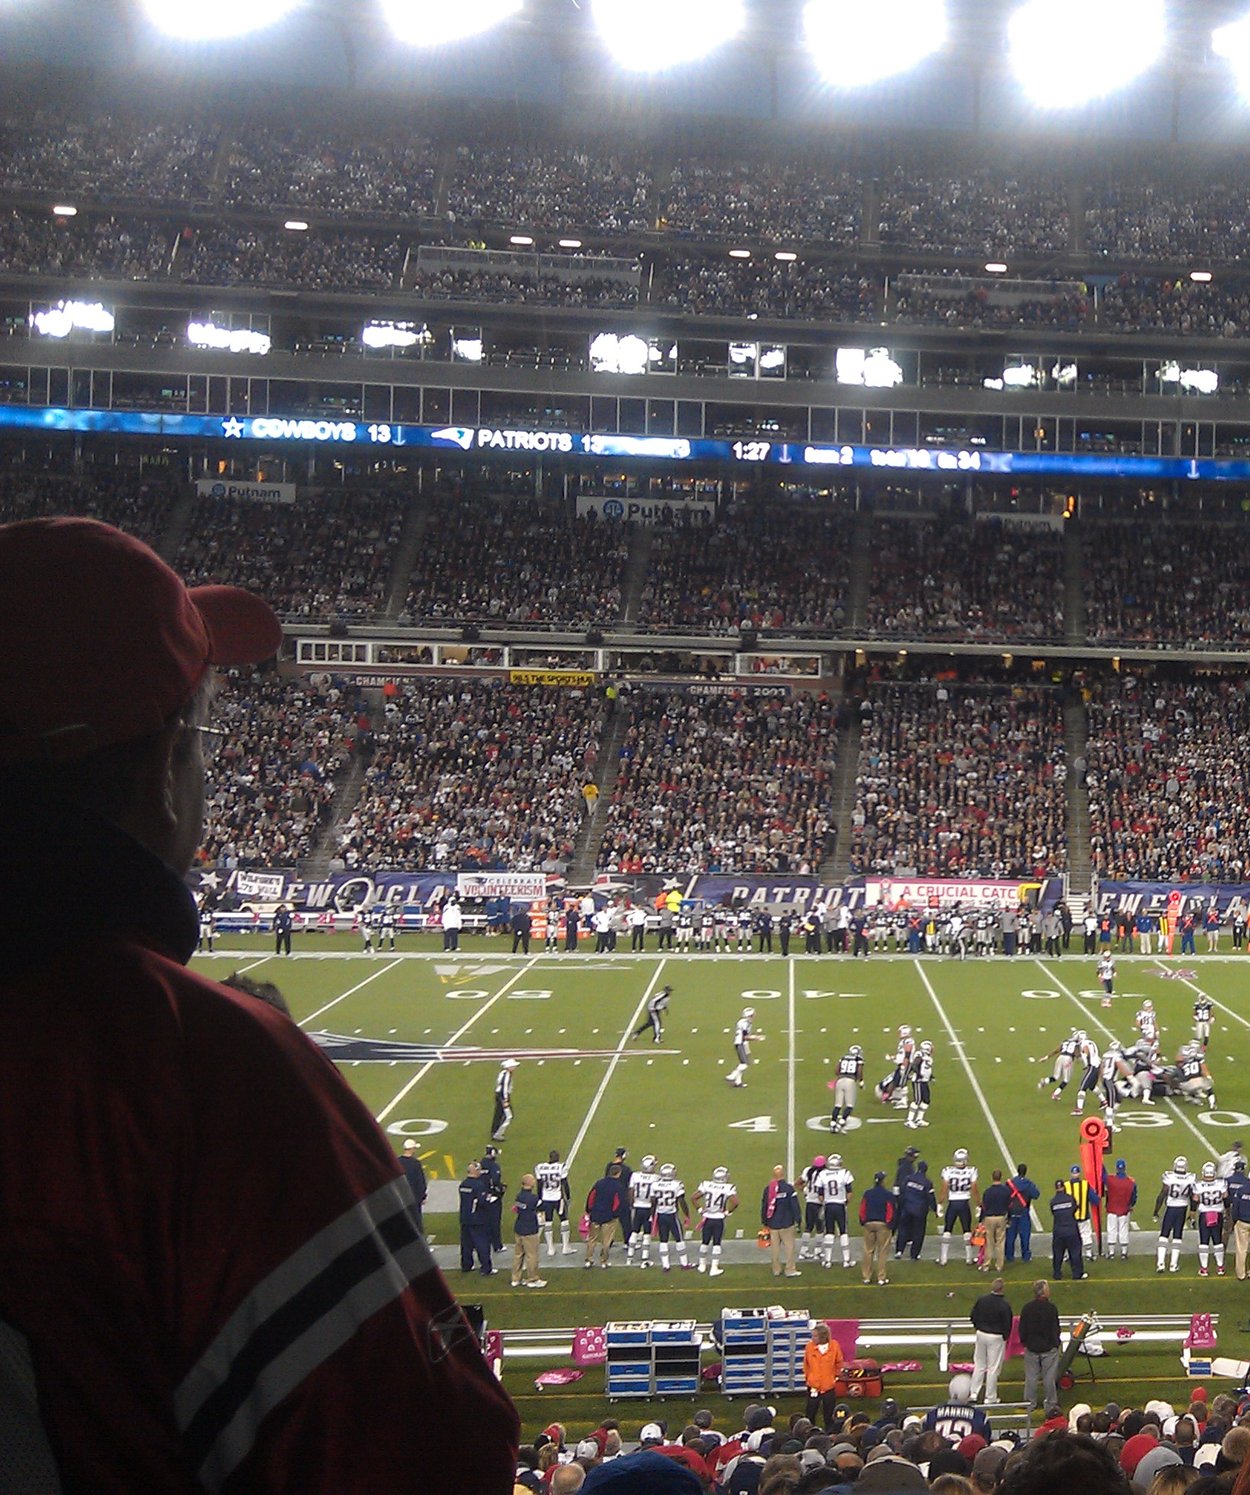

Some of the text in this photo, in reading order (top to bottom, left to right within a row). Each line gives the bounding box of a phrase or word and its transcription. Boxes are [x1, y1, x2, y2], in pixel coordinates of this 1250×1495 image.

[251, 419, 391, 443] COWBOYS 13
[478, 429, 573, 452] PATRIOTS
[732, 441, 770, 461] 1:27
[228, 486, 281, 499] Putnam
[464, 885, 543, 897] VOLUNTEERISM
[902, 886, 1017, 899] A CRUCIAL CATC
[841, 1060, 857, 1074] 98
[828, 1179, 839, 1196] 8
[1169, 1184, 1192, 1199] 64
[655, 1190, 676, 1207] 22
[1200, 1190, 1222, 1206] 62
